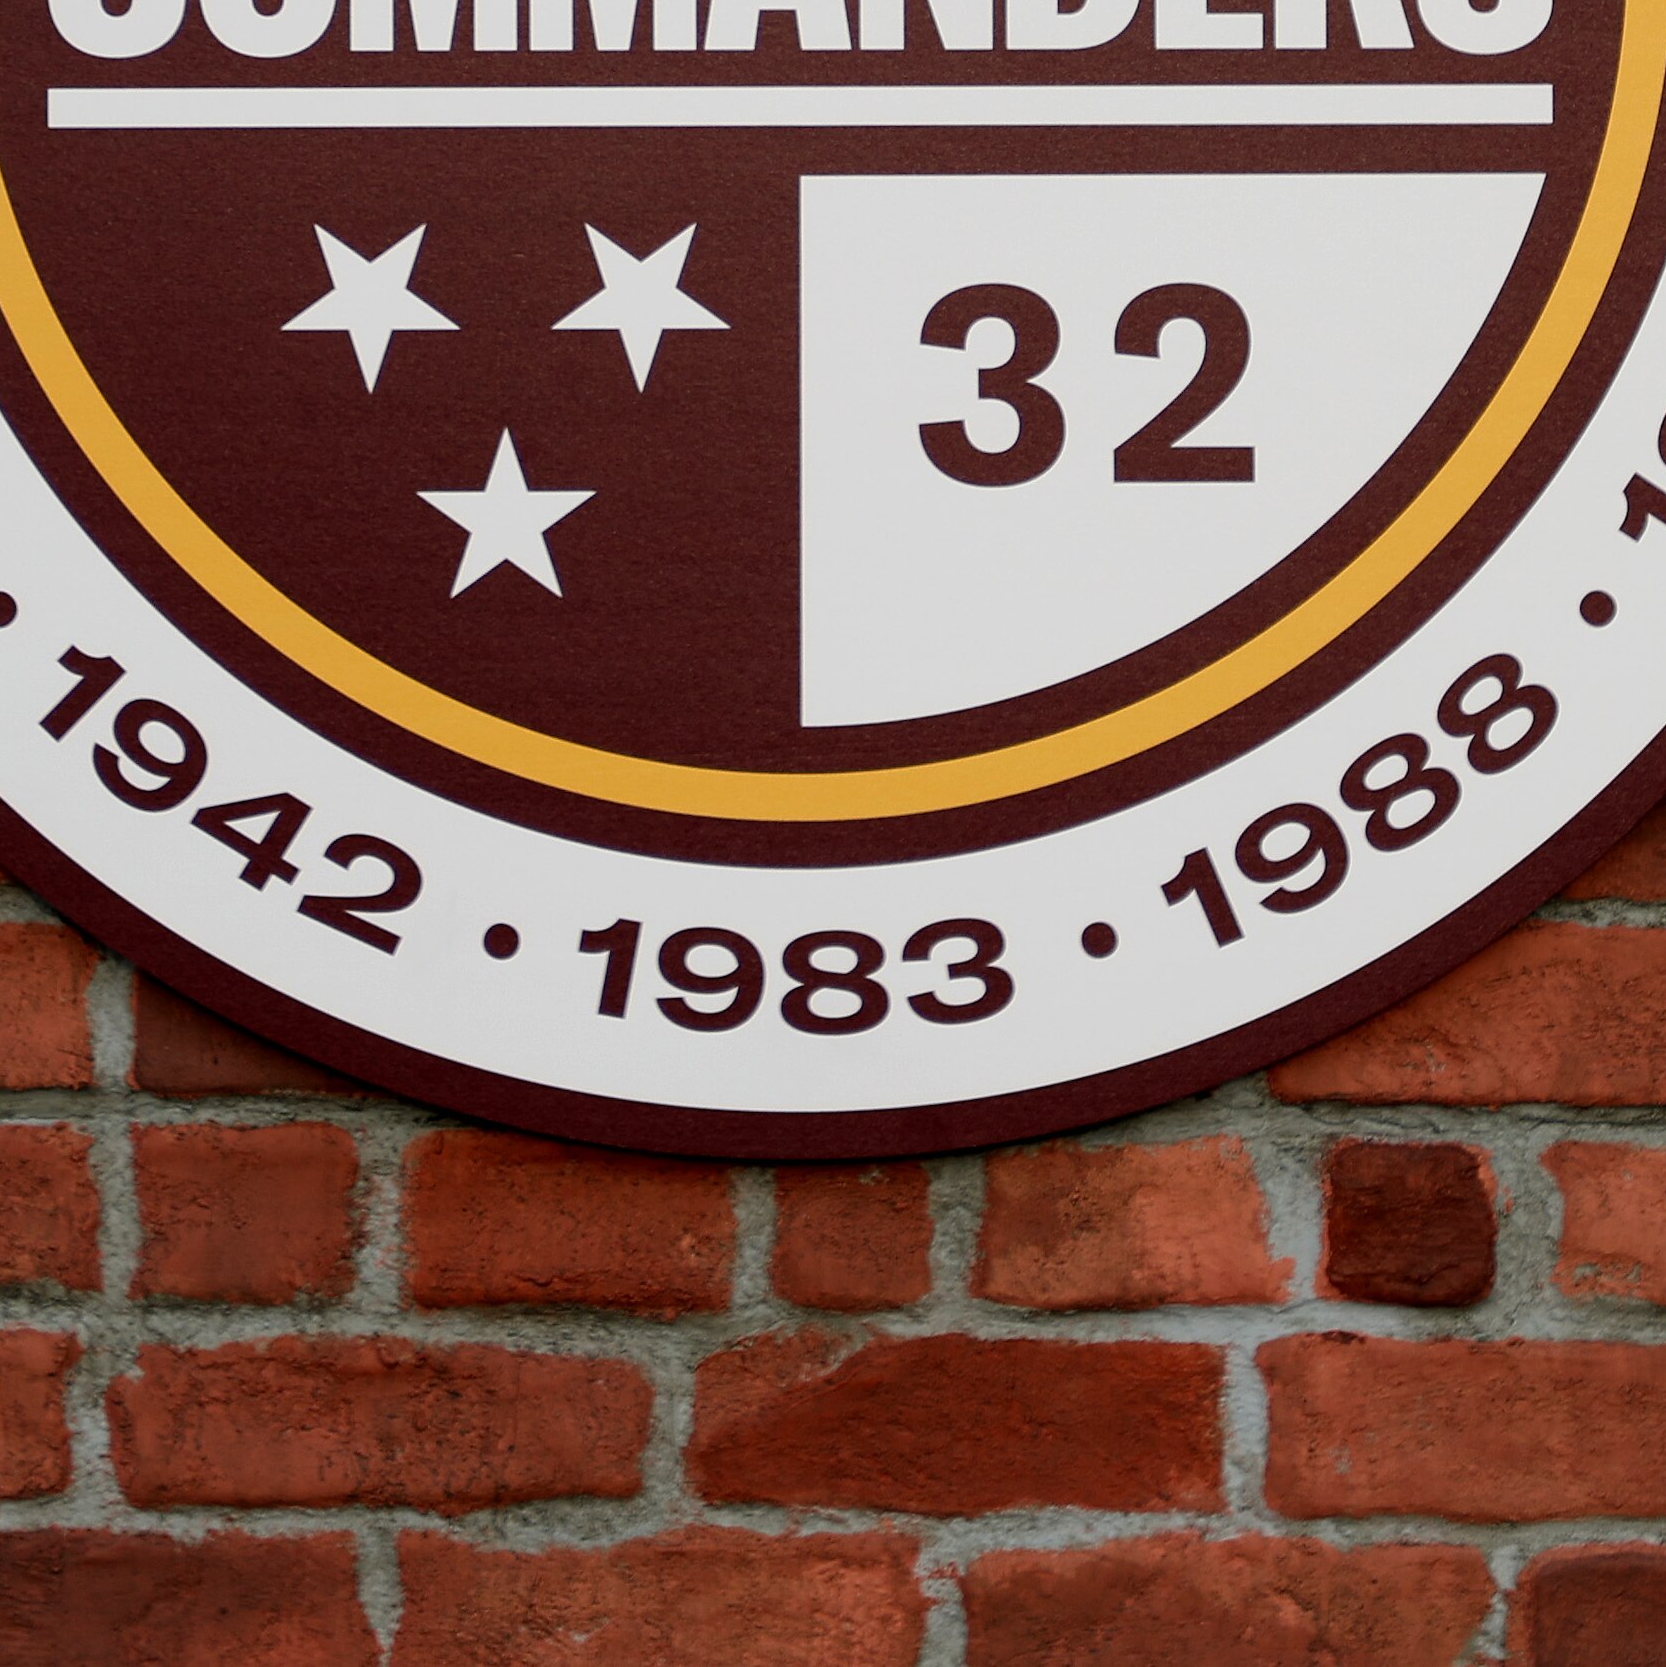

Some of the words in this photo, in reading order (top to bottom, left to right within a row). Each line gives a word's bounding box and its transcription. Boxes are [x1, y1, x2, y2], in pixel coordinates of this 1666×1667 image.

[919, 283, 1254, 487] 32
[39, 646, 422, 955] 1942
[579, 918, 1013, 1035] 1983
[1161, 654, 1558, 947] 1988
